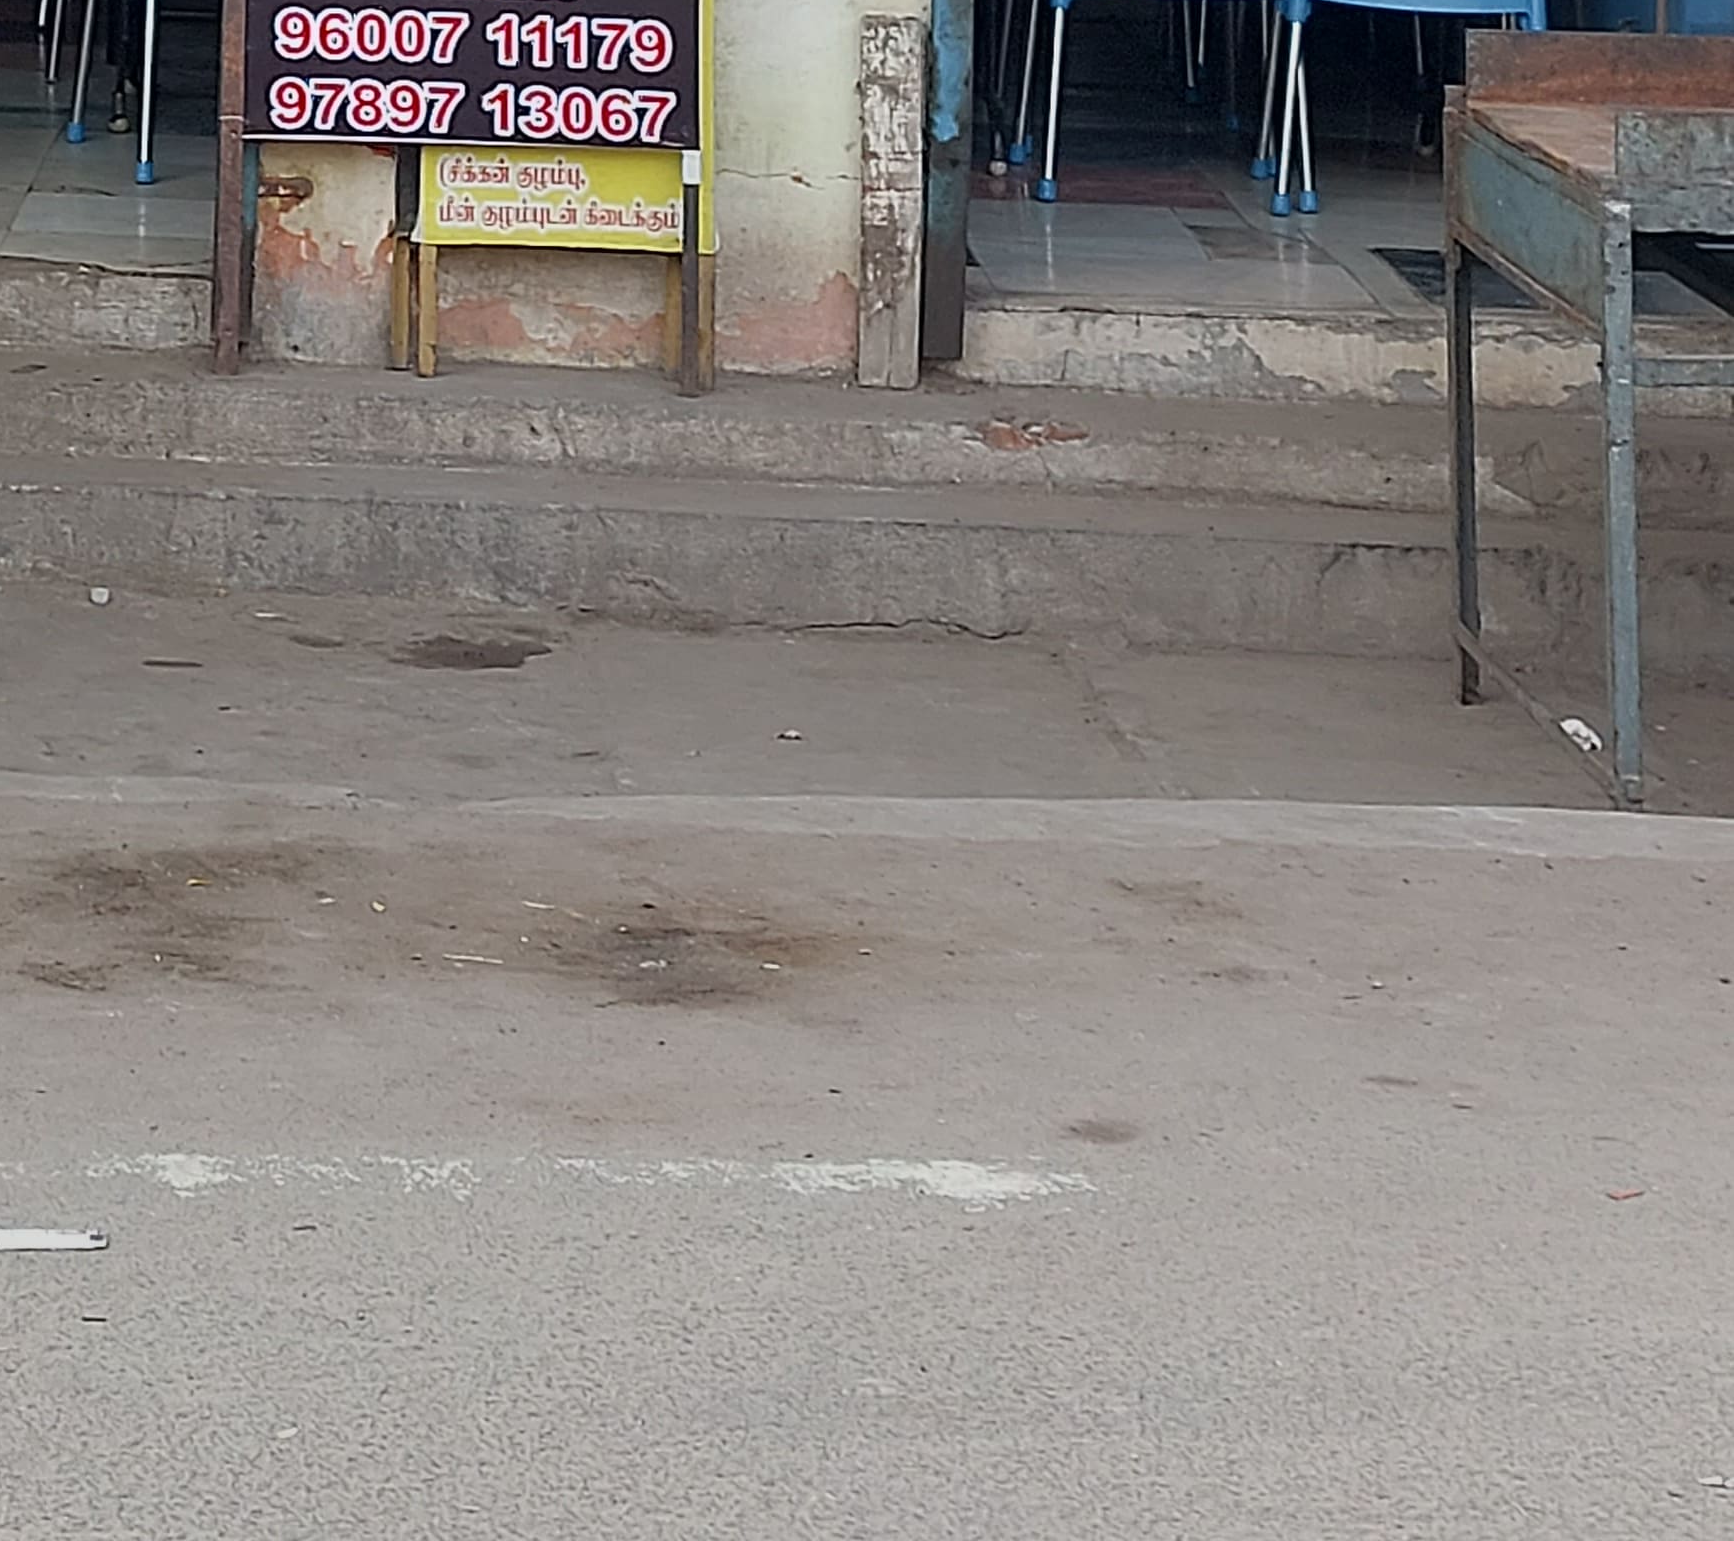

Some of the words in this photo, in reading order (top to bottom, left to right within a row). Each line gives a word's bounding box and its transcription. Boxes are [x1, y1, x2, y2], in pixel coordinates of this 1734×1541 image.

[274, 5, 469, 66] 96007
[485, 12, 674, 73] 11179
[269, 76, 467, 135] 97897
[481, 82, 678, 144] 13067
